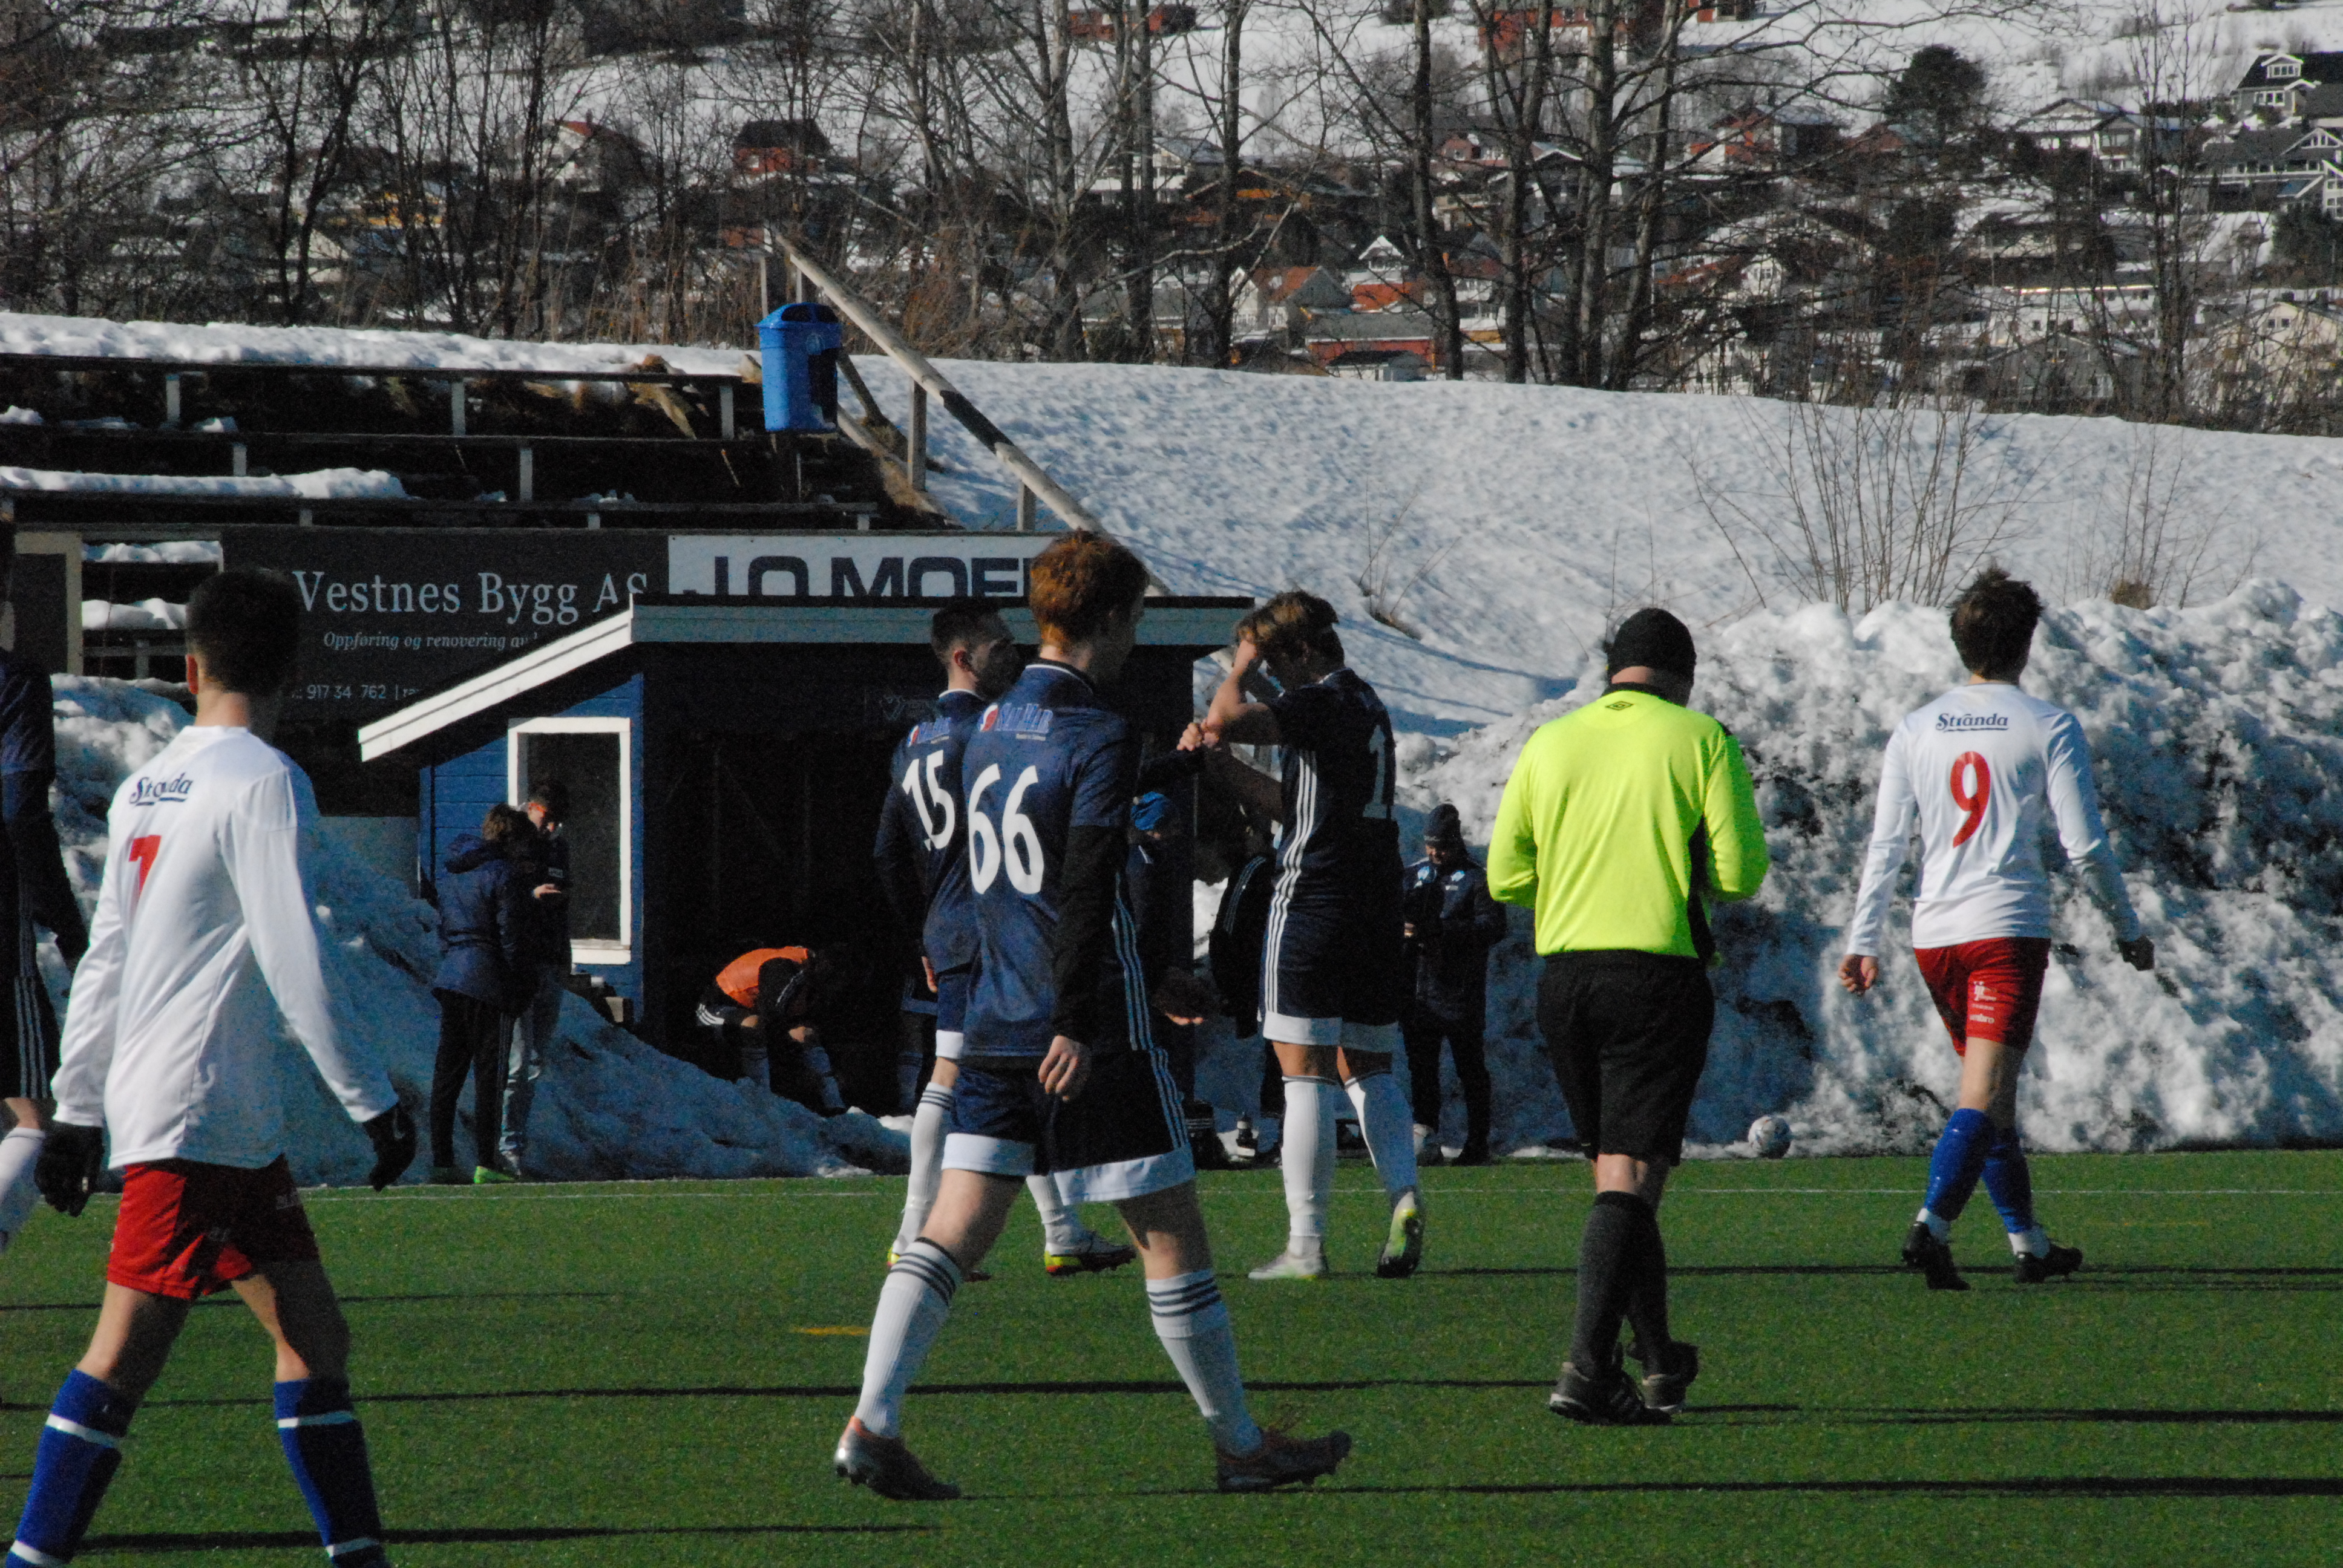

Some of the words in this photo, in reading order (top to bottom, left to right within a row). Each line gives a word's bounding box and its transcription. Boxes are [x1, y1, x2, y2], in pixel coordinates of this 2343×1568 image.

[292, 570, 460, 613] Vestnes
[478, 572, 578, 625] Bygg
[831, 556, 1031, 596] MOE
[404, 636, 422, 650] og
[426, 631, 506, 652] renovering
[306, 684, 330, 700] 917
[333, 684, 352, 699] 34
[360, 684, 386, 699] 762
[1935, 713, 2008, 731] Stranda
[902, 749, 955, 851] 15
[1950, 751, 1991, 849] 9
[968, 763, 1045, 895] 66
[128, 834, 162, 899] 7
